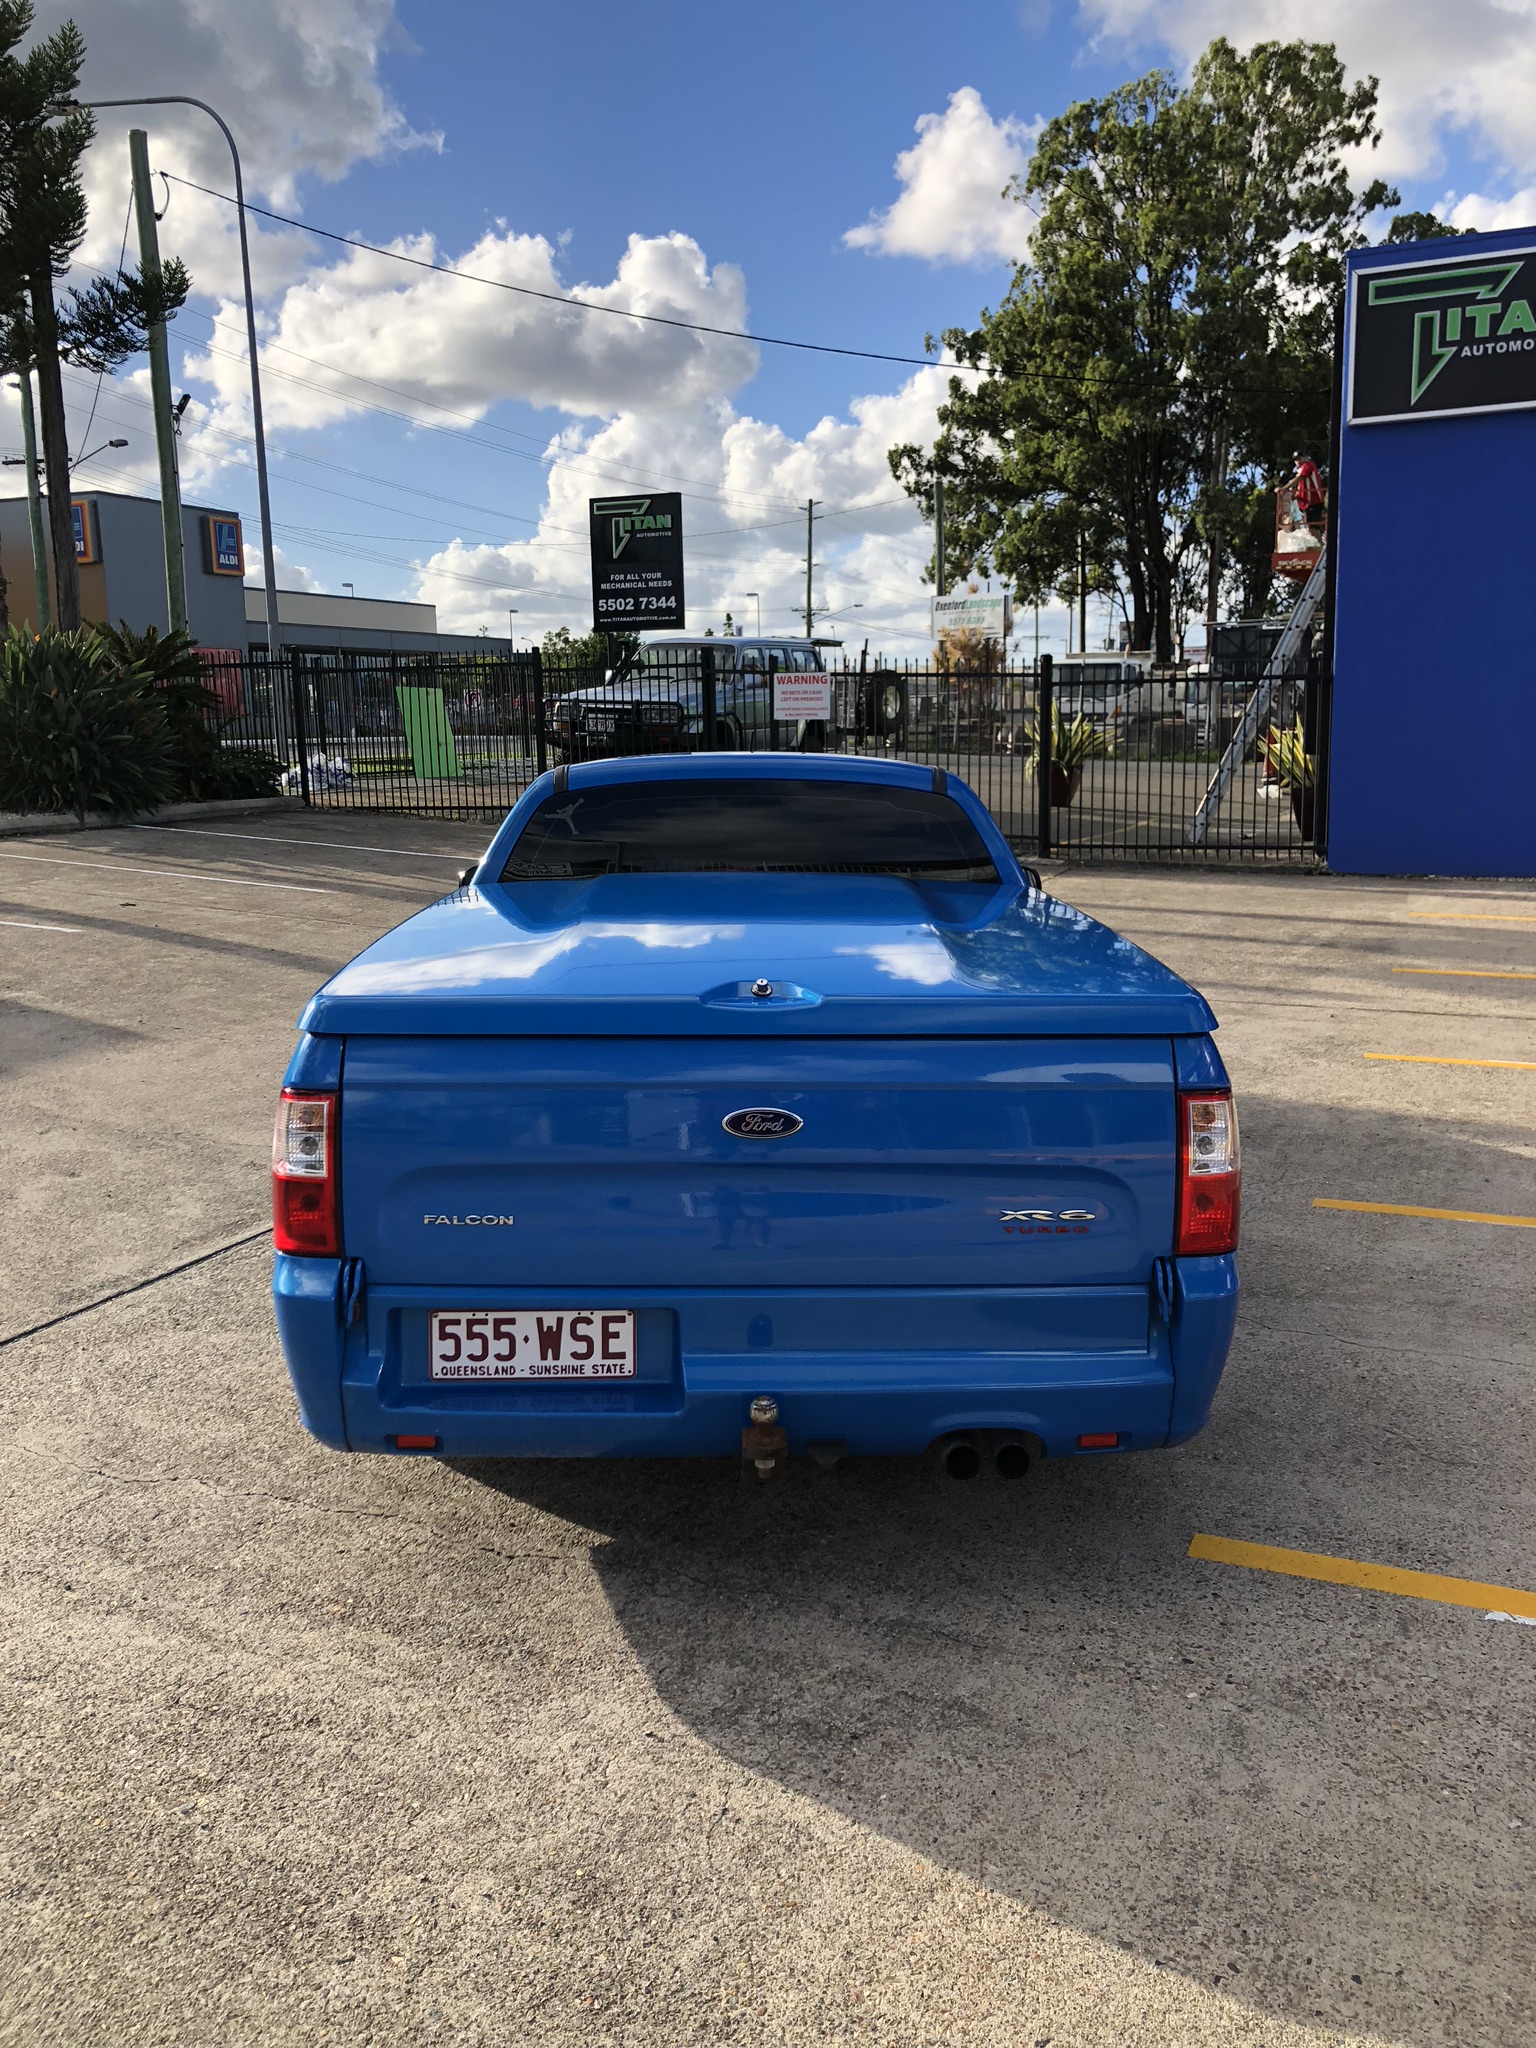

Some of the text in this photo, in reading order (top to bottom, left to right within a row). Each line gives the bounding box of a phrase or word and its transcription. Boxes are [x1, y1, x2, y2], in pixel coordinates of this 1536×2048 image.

[594, 499, 672, 559] TITAN
[219, 553, 238, 566] ALDI
[641, 572, 662, 580] YOUR
[600, 581, 647, 590] MECHANICAL
[598, 595, 677, 611] 5502 7344
[776, 675, 828, 685] WARNING
[741, 1113, 784, 1131] Ford
[423, 1214, 514, 1225] FALCON
[999, 1209, 1096, 1220] XR6
[1003, 1225, 1089, 1234] TURBO
[440, 1365, 516, 1376] QUEENSLAND
[529, 1364, 586, 1375] SUNSHINE
[592, 1363, 626, 1374] STATE
